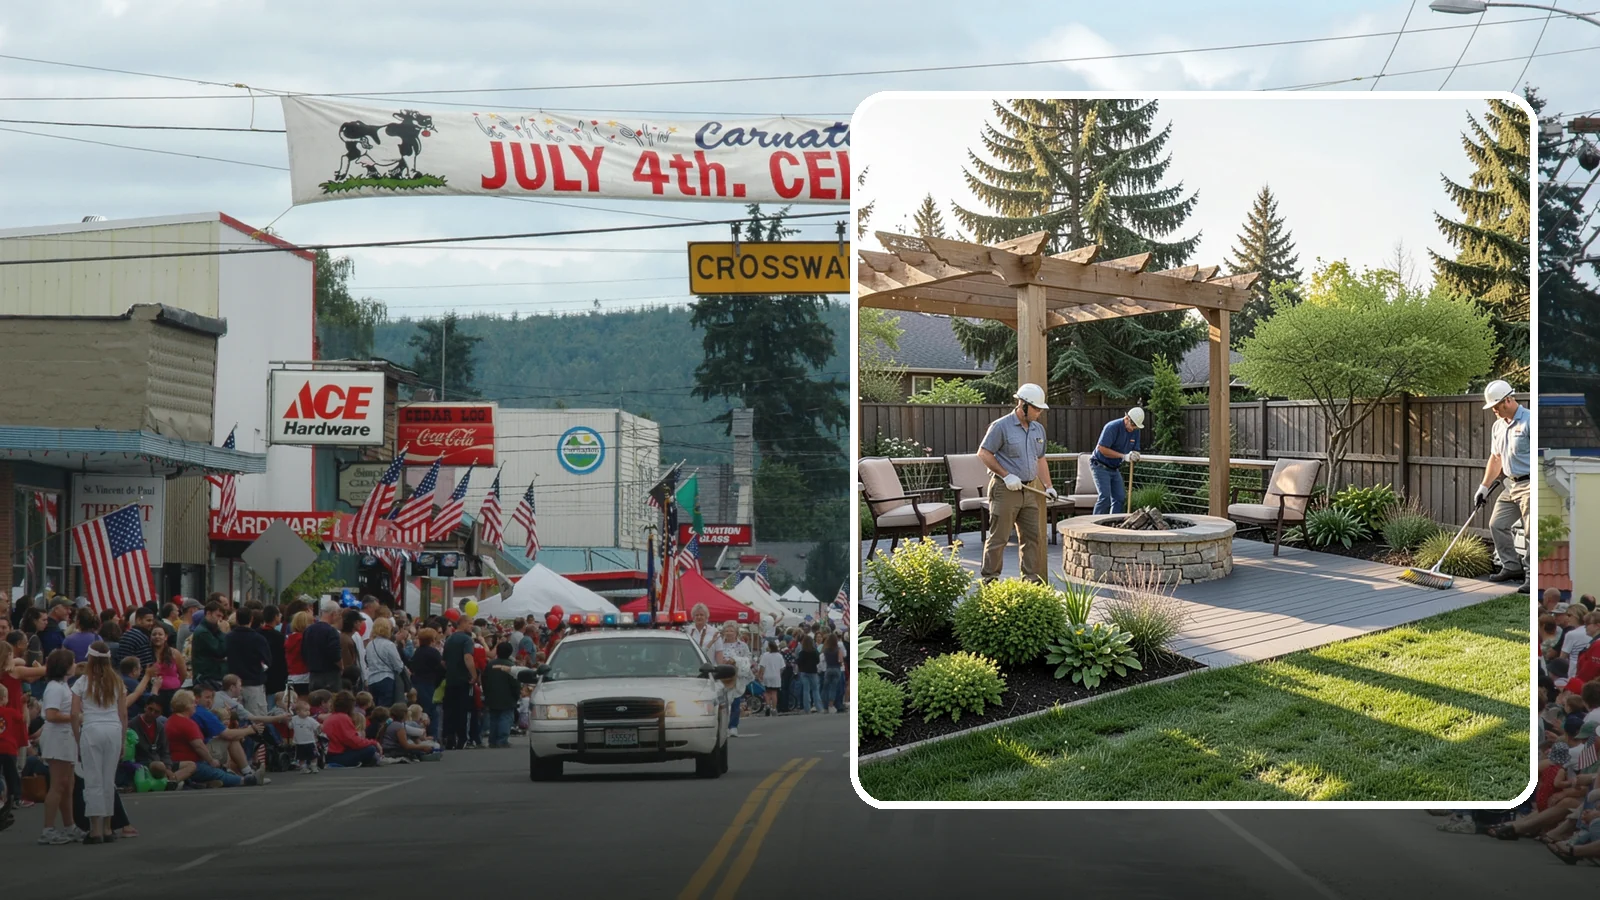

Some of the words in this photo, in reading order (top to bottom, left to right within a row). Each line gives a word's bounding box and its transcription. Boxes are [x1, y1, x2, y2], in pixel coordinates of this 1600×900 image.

[695, 121, 850, 149] Carnat
[481, 141, 605, 192] JULY
[632, 150, 746, 197] 4th.
[697, 254, 850, 280] CROSSWA
[282, 380, 374, 420] ACE
[406, 409, 453, 422] CEDAR
[283, 421, 371, 436] Hardware
[416, 428, 477, 447] Coca-Cola
[353, 467, 384, 480] Simpl
[83, 485, 93, 494] St.
[95, 485, 124, 495] Vincent
[126, 486, 136, 495] de
[137, 486, 155, 495] Paul
[688, 526, 741, 535] CRNATION
[699, 535, 730, 543] GLASS
